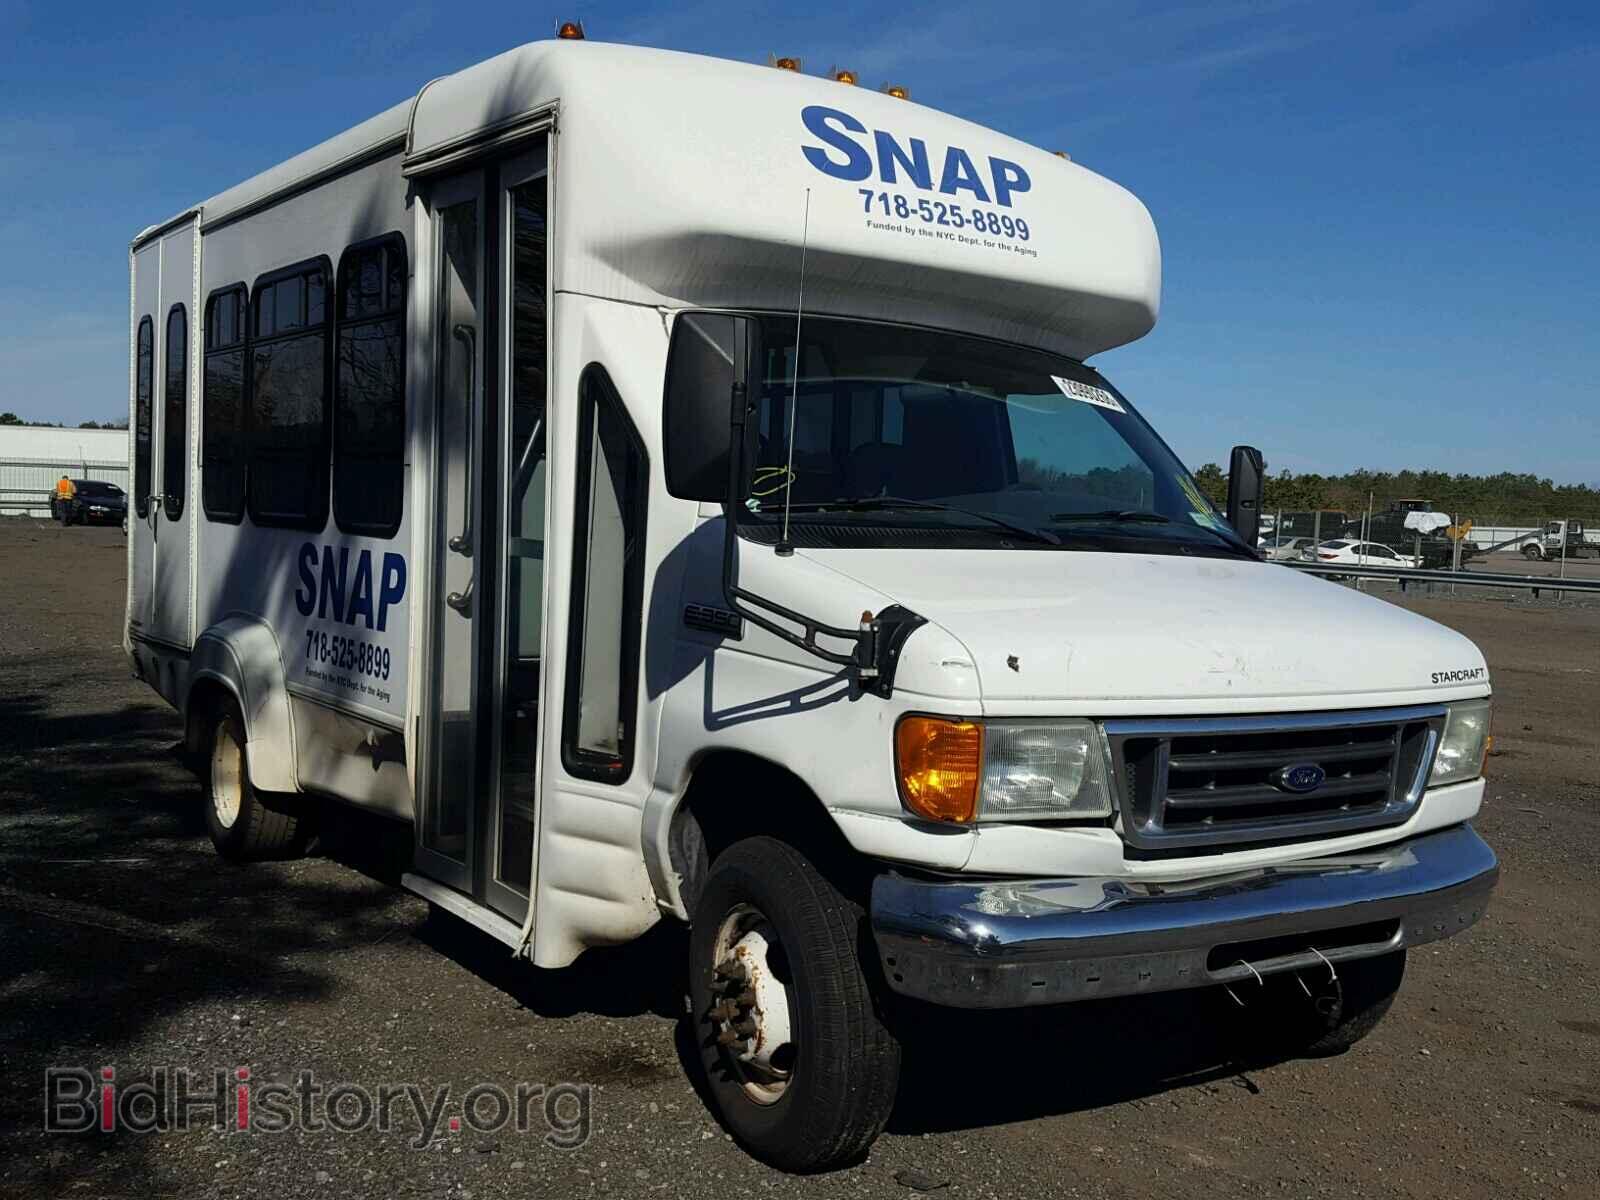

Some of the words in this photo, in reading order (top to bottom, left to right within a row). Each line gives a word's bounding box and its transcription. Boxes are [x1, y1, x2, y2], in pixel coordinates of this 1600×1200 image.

[801, 105, 1031, 208] SNAP
[858, 188, 1030, 241] 718-525-8899
[866, 220, 902, 232] Funded
[905, 225, 916, 236] by
[919, 228, 933, 238] the
[936, 231, 955, 241] NYC
[958, 234, 981, 245] Dept.
[984, 239, 995, 247] for
[998, 242, 1011, 251] the
[1014, 245, 1037, 257] Aging
[295, 542, 407, 632] SNAP
[306, 630, 391, 681] 718-525-8899
[1431, 667, 1484, 684] STARCRAFT
